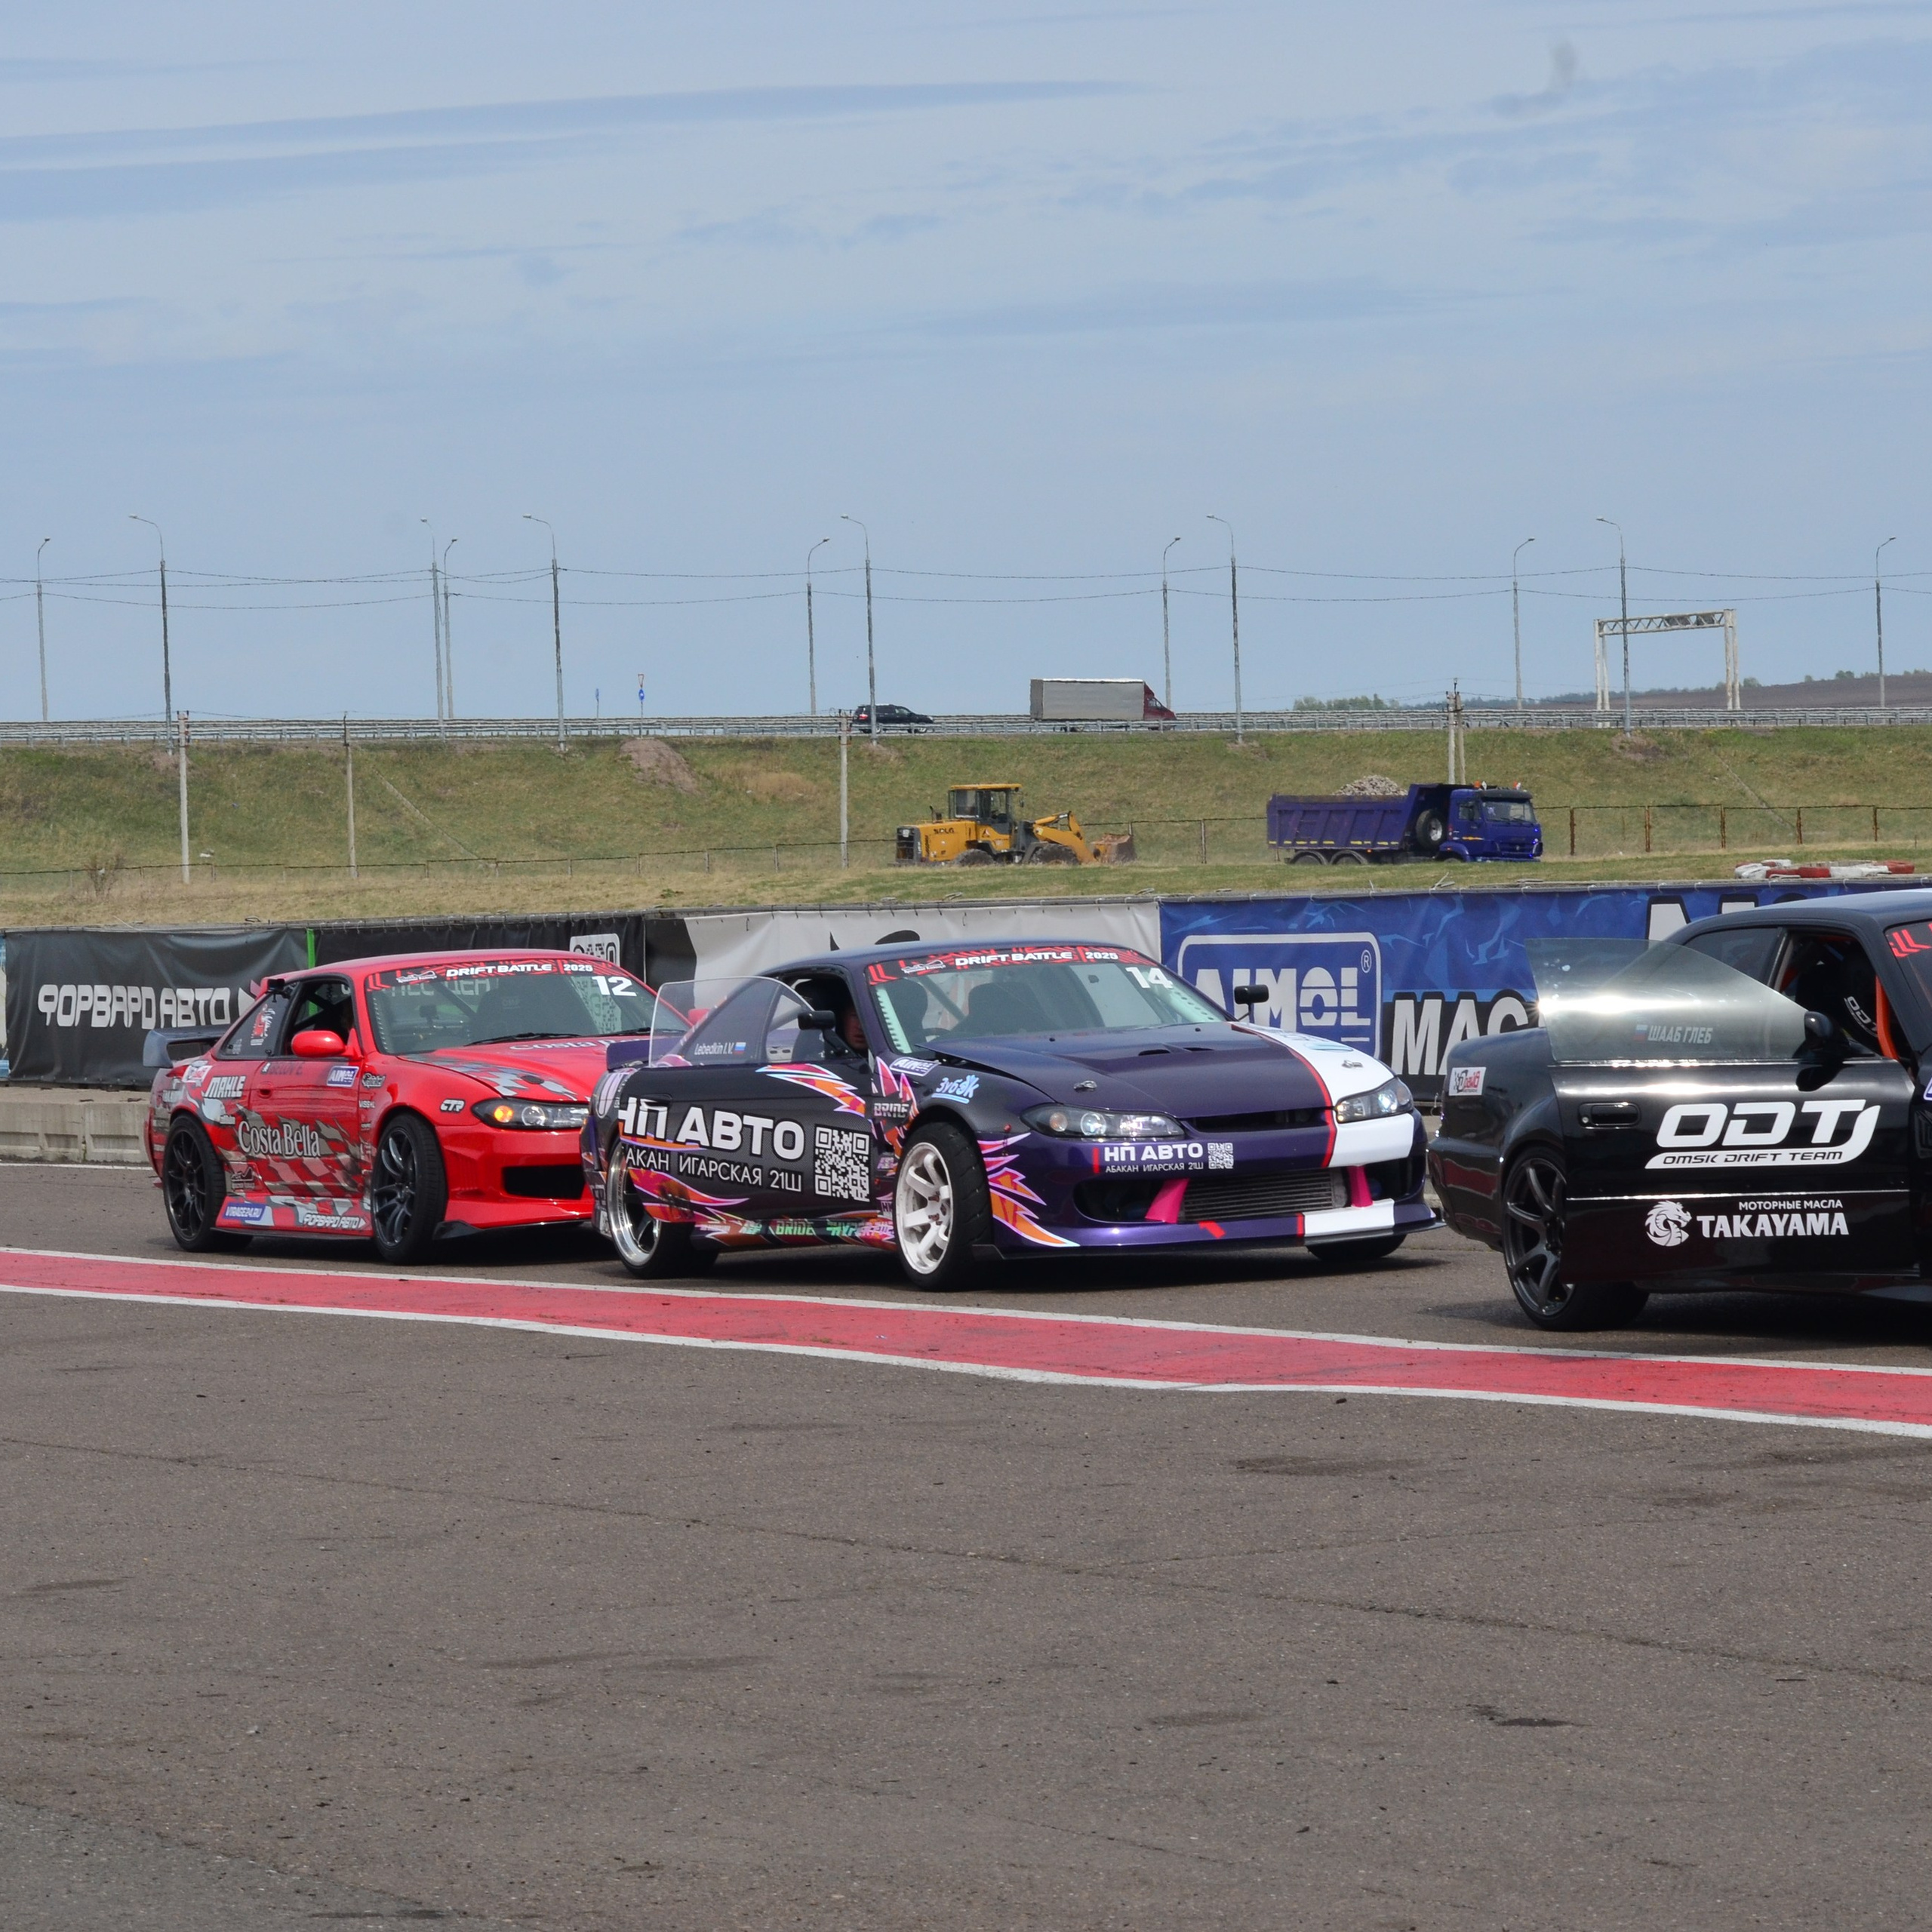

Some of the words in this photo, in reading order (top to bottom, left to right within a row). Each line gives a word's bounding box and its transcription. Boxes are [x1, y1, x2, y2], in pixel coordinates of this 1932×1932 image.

[955, 954, 1010, 965] DRIFT
[1011, 952, 1072, 961] BATTLE
[1085, 951, 1118, 960] 2025
[446, 965, 496, 977] DRIFT
[497, 963, 552, 974] BATTLE
[564, 964, 593, 972] 2025
[1125, 966, 1173, 989] 14
[592, 976, 637, 997] 12
[160, 987, 230, 1028] АВТО
[1647, 1026, 1682, 1042] ШААБ
[1682, 1026, 1713, 1044] ГЛЕБ
[202, 1076, 246, 1098] MAHLE
[676, 1107, 804, 1160] АВТО
[1656, 1099, 1867, 1147] ODT
[238, 1121, 283, 1156] Costa
[284, 1122, 321, 1158] Bella
[1104, 1146, 1136, 1161] НП
[1140, 1143, 1204, 1161] АВТО
[1663, 1154, 1719, 1164] OMSK
[1724, 1152, 1782, 1163] DRIFT
[1789, 1151, 1842, 1161] TEAM
[679, 1157, 762, 1186] ИГАРСКАЯ
[770, 1170, 801, 1192] 21Ш
[1106, 1164, 1139, 1173] АБАКАН
[1143, 1162, 1185, 1172] ИГАРСКАЯ
[1738, 1200, 1801, 1211] МОТОРНЫЕ
[1804, 1198, 1843, 1209] МАСЛА
[1696, 1212, 1849, 1238] TAKAYAMA
